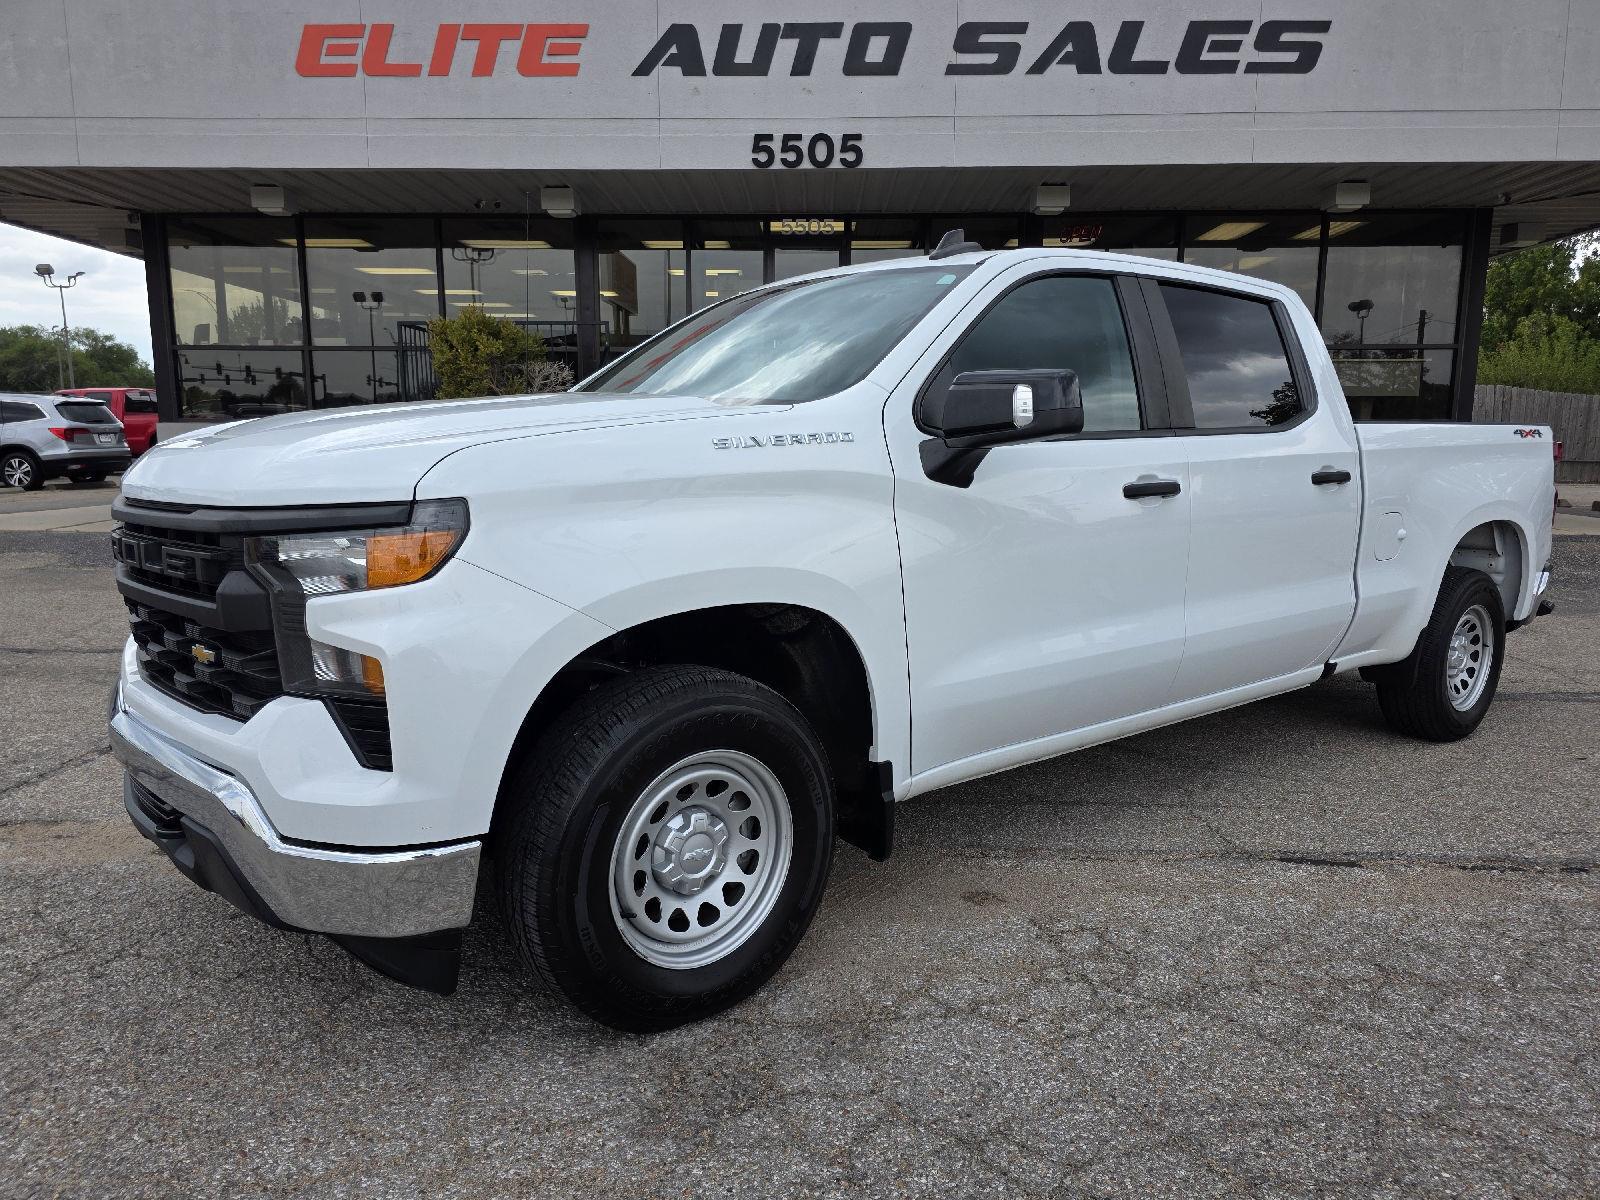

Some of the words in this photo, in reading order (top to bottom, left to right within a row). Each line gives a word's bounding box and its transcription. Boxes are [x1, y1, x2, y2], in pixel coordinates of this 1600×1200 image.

[295, 24, 589, 77] ELITE
[631, 22, 912, 76] AUTO
[945, 20, 1332, 75] SALES
[752, 133, 863, 168] 5505
[781, 219, 835, 235] 5505
[1059, 225, 1103, 243] OPEN
[712, 432, 855, 449] SILVERADO
